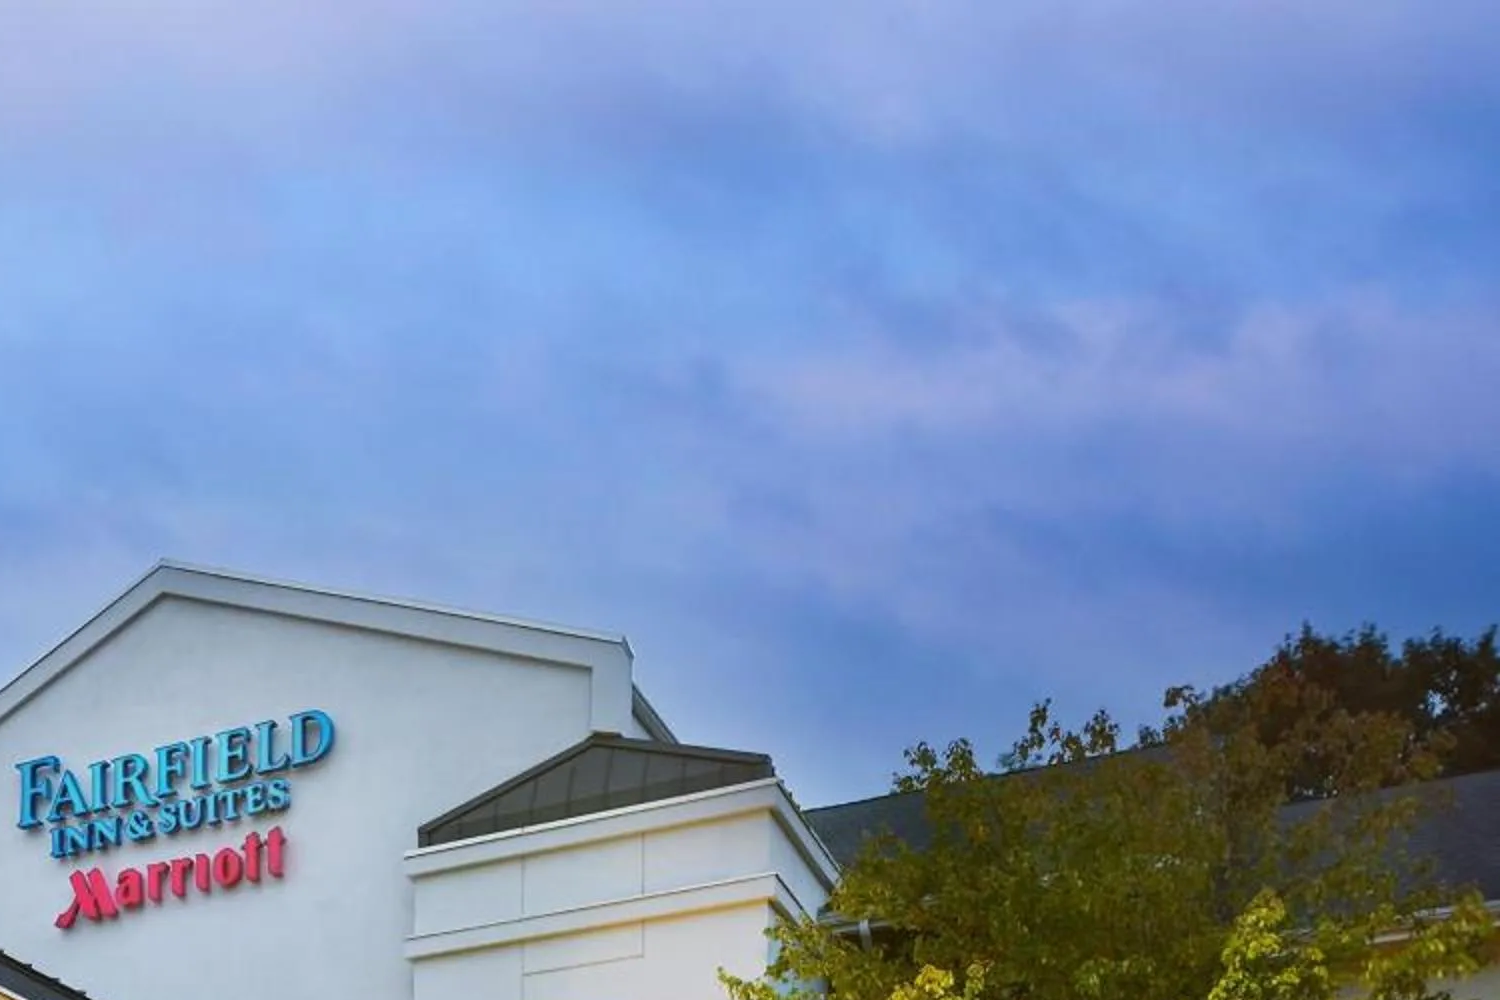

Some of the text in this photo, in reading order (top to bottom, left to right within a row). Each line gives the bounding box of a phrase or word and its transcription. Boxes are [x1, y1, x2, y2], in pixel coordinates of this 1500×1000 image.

[15, 709, 336, 831] FAIRFIELD
[158, 778, 292, 834] SUITES
[54, 826, 288, 930] Marriott
